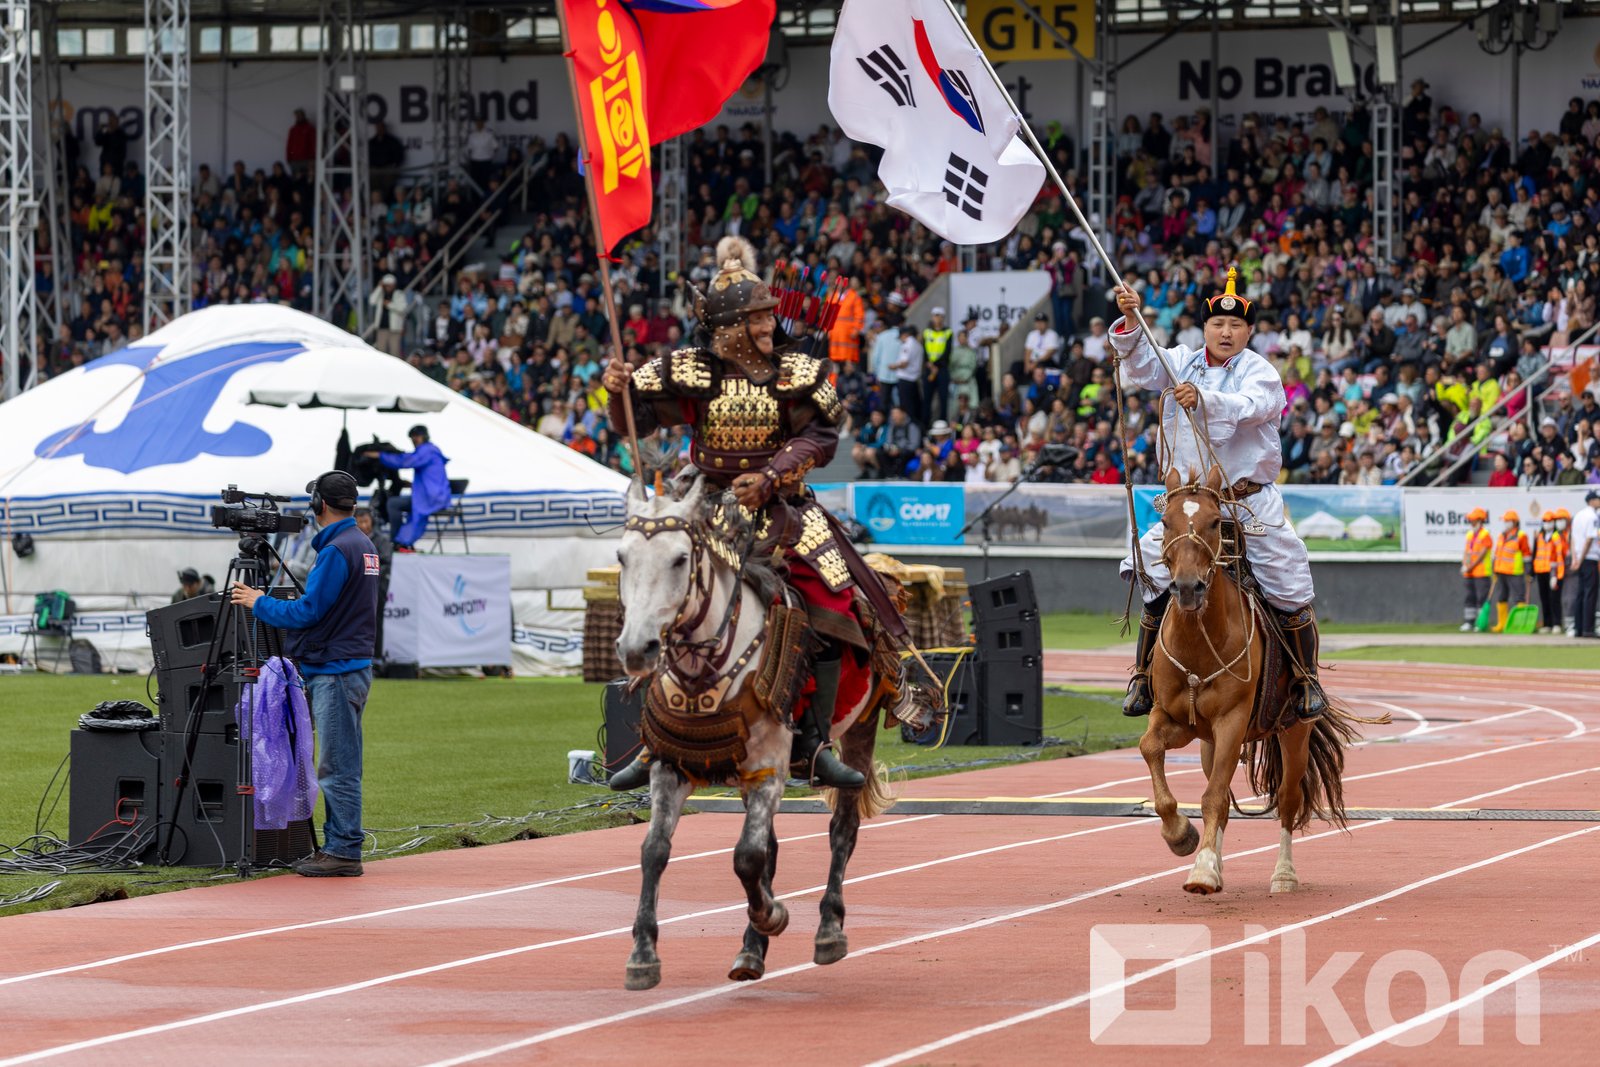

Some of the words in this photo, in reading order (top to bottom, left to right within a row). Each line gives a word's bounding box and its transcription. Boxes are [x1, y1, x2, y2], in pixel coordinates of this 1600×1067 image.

[982, 4, 1078, 51] G15
[1179, 59, 1243, 100] No
[1425, 511, 1445, 525] No
